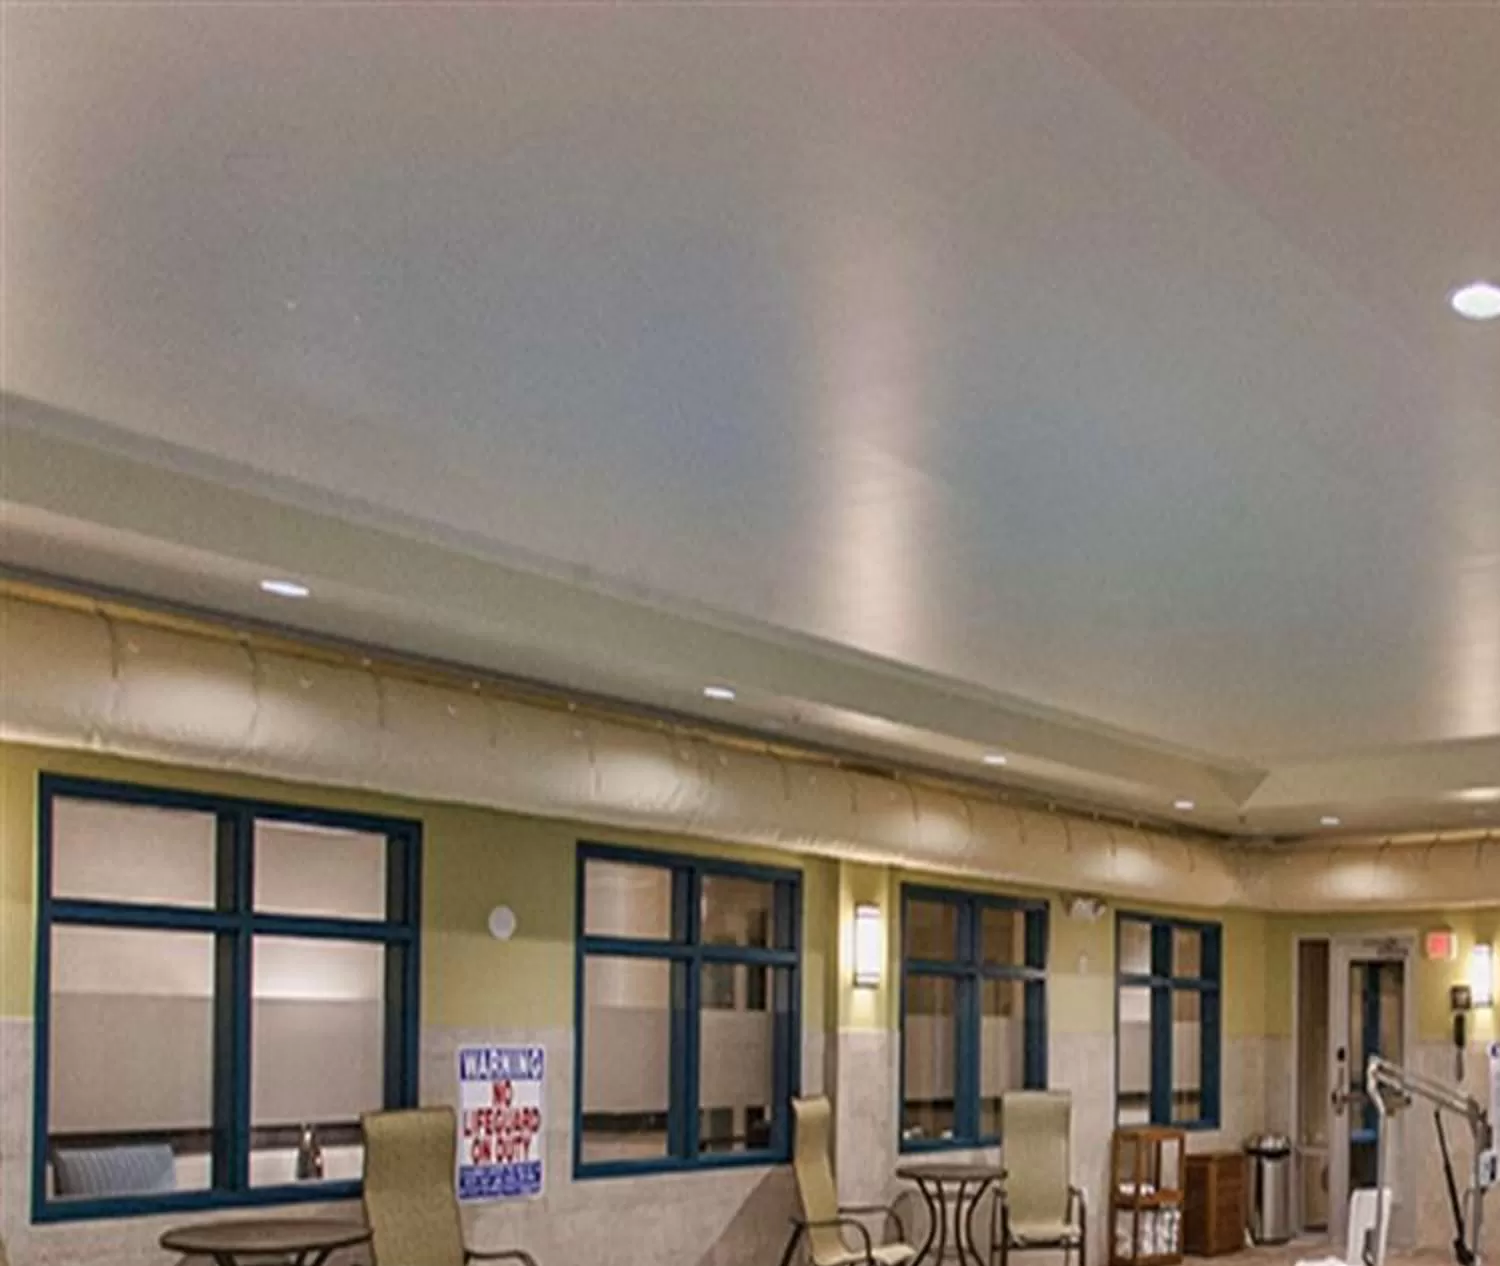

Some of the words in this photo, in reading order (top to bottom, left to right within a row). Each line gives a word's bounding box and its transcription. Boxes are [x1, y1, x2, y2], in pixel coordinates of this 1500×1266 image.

[463, 1050, 542, 1079] WARNING
[493, 1080, 511, 1107] NO
[463, 1107, 540, 1137] LIFEGUARD
[472, 1137, 492, 1165] ON
[496, 1136, 530, 1162] DUTY
